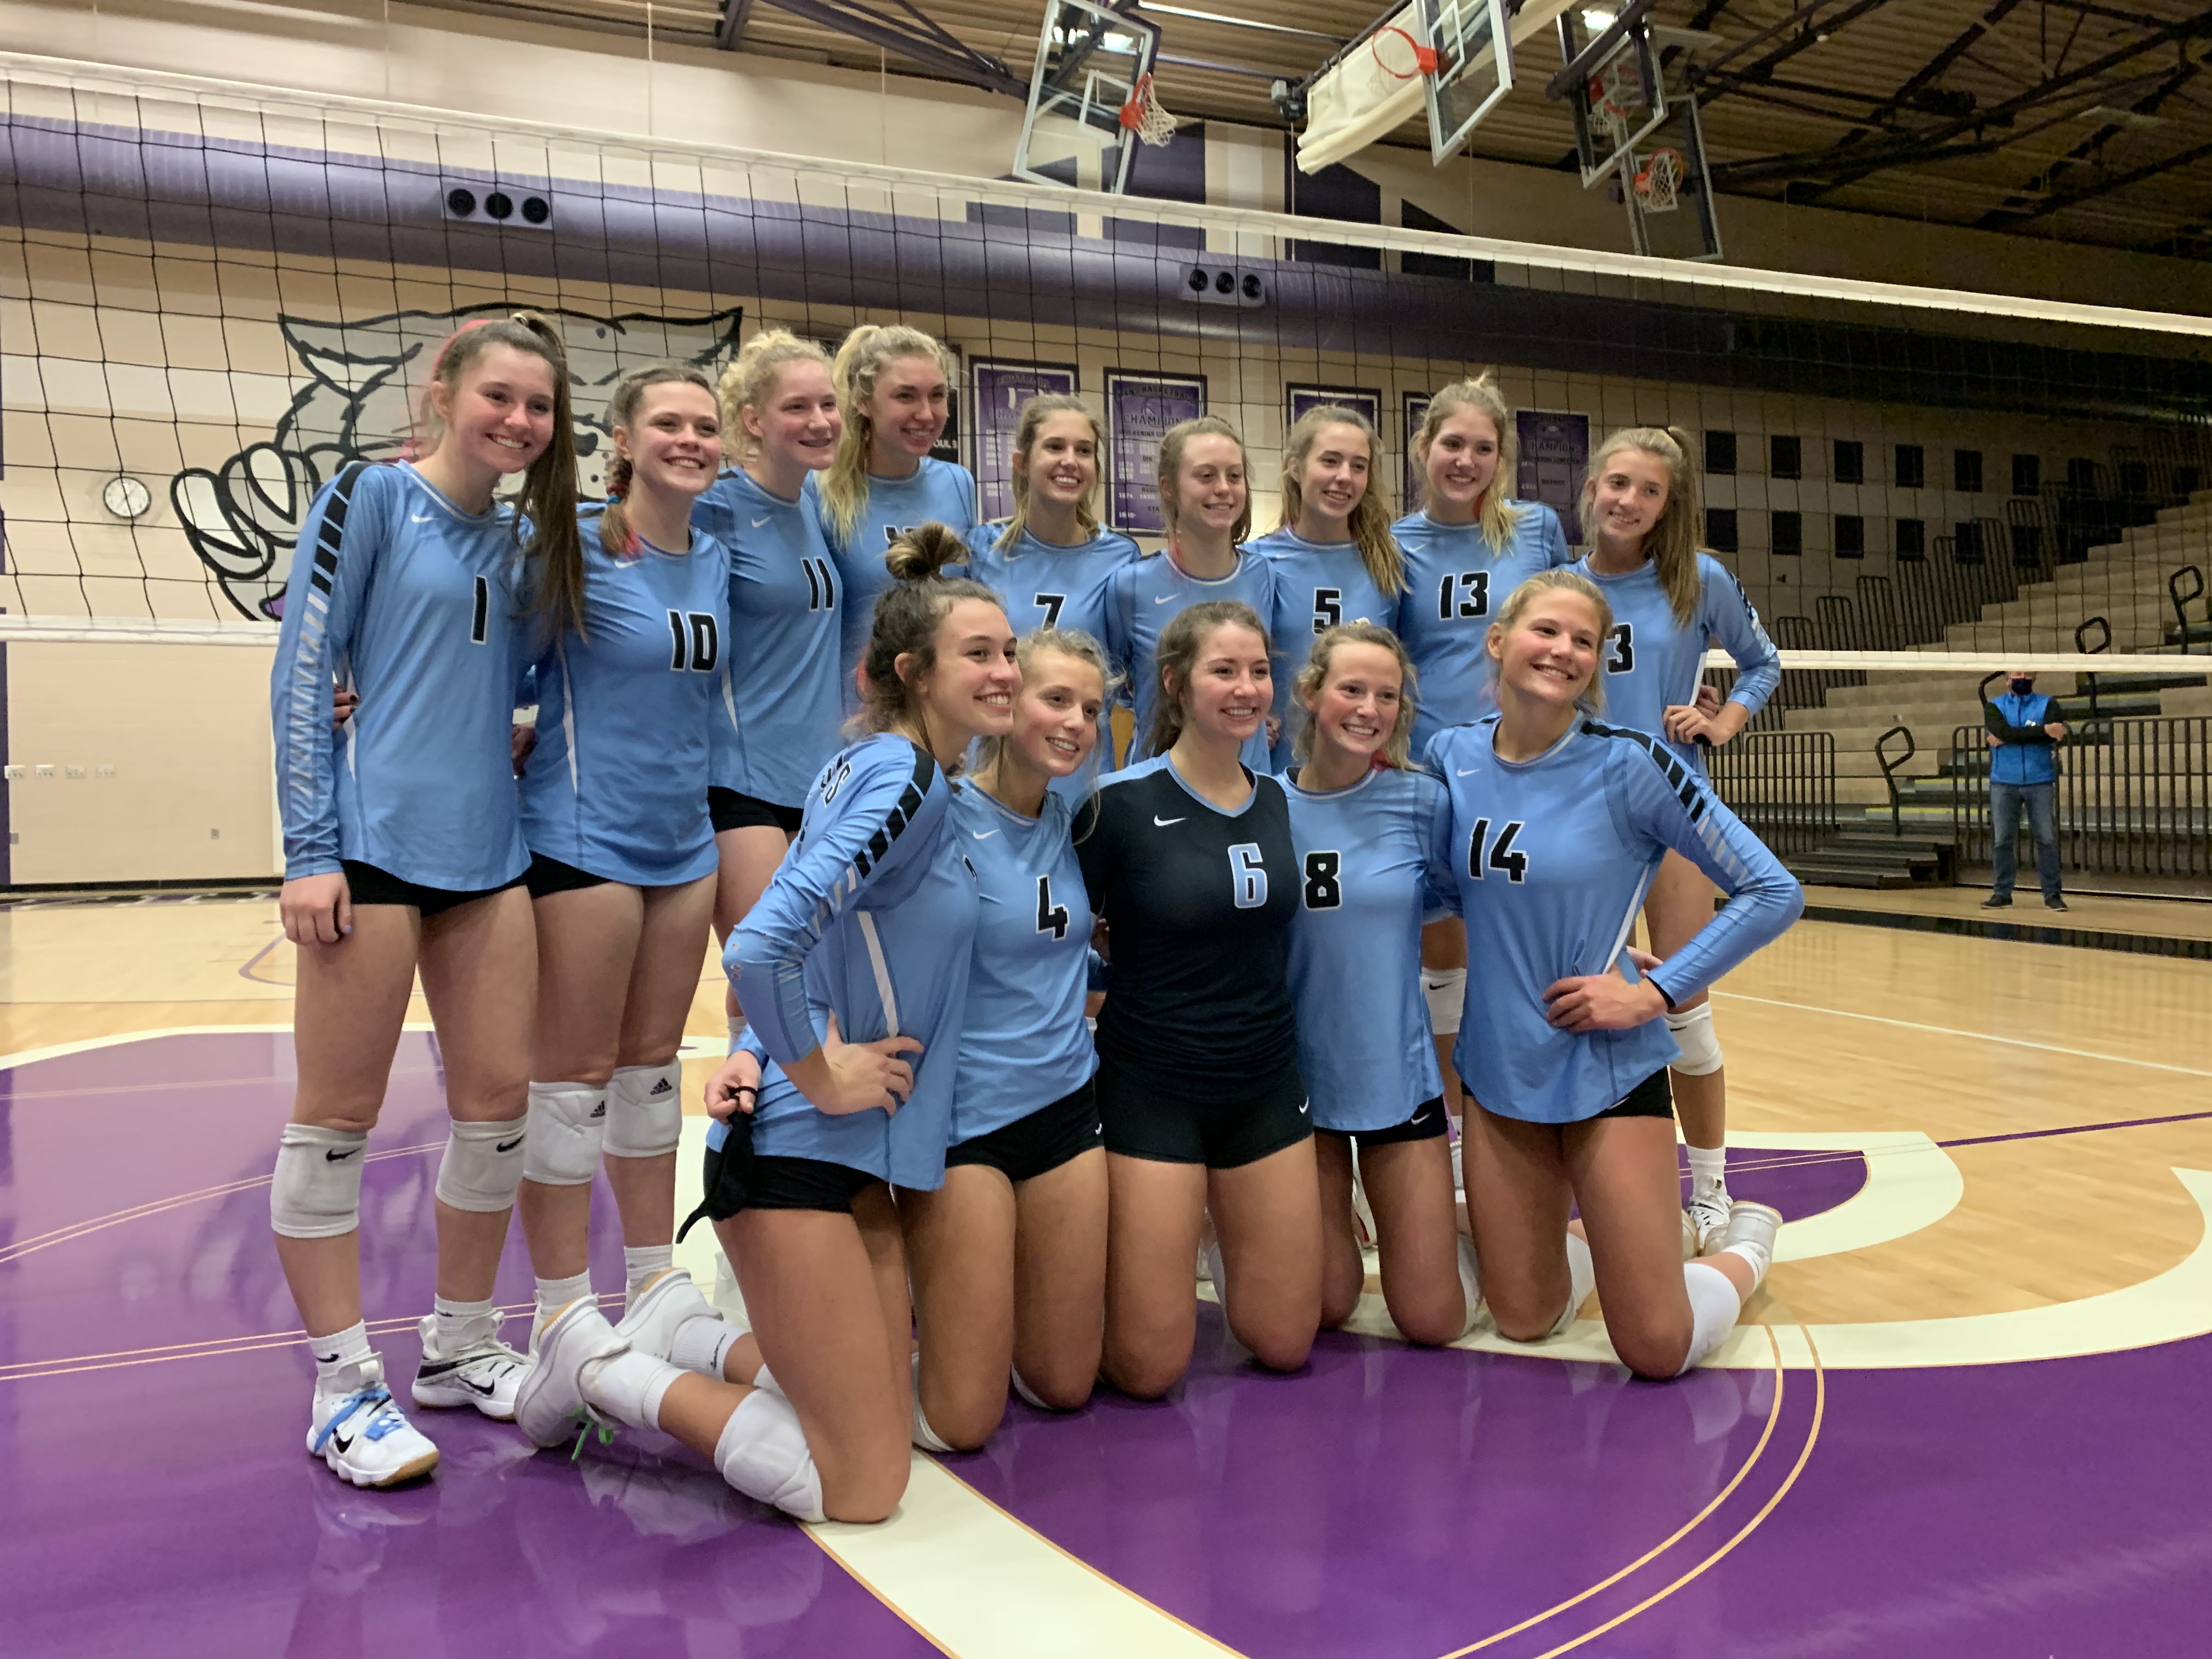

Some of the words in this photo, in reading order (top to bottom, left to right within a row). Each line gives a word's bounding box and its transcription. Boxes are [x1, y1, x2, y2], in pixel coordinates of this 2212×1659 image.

[933, 438, 957, 449] OULS
[1123, 413, 1182, 427] CHAMPION
[470, 574, 490, 645] 1
[800, 556, 834, 612] 11
[1033, 592, 1066, 629] 7
[1313, 586, 1343, 634] 5
[1437, 570, 1490, 621] 13
[667, 608, 718, 673] 10
[1227, 843, 1268, 910] 6
[1468, 817, 1530, 885] 14
[1035, 873, 1070, 941] 4
[1303, 850, 1343, 911] 8
